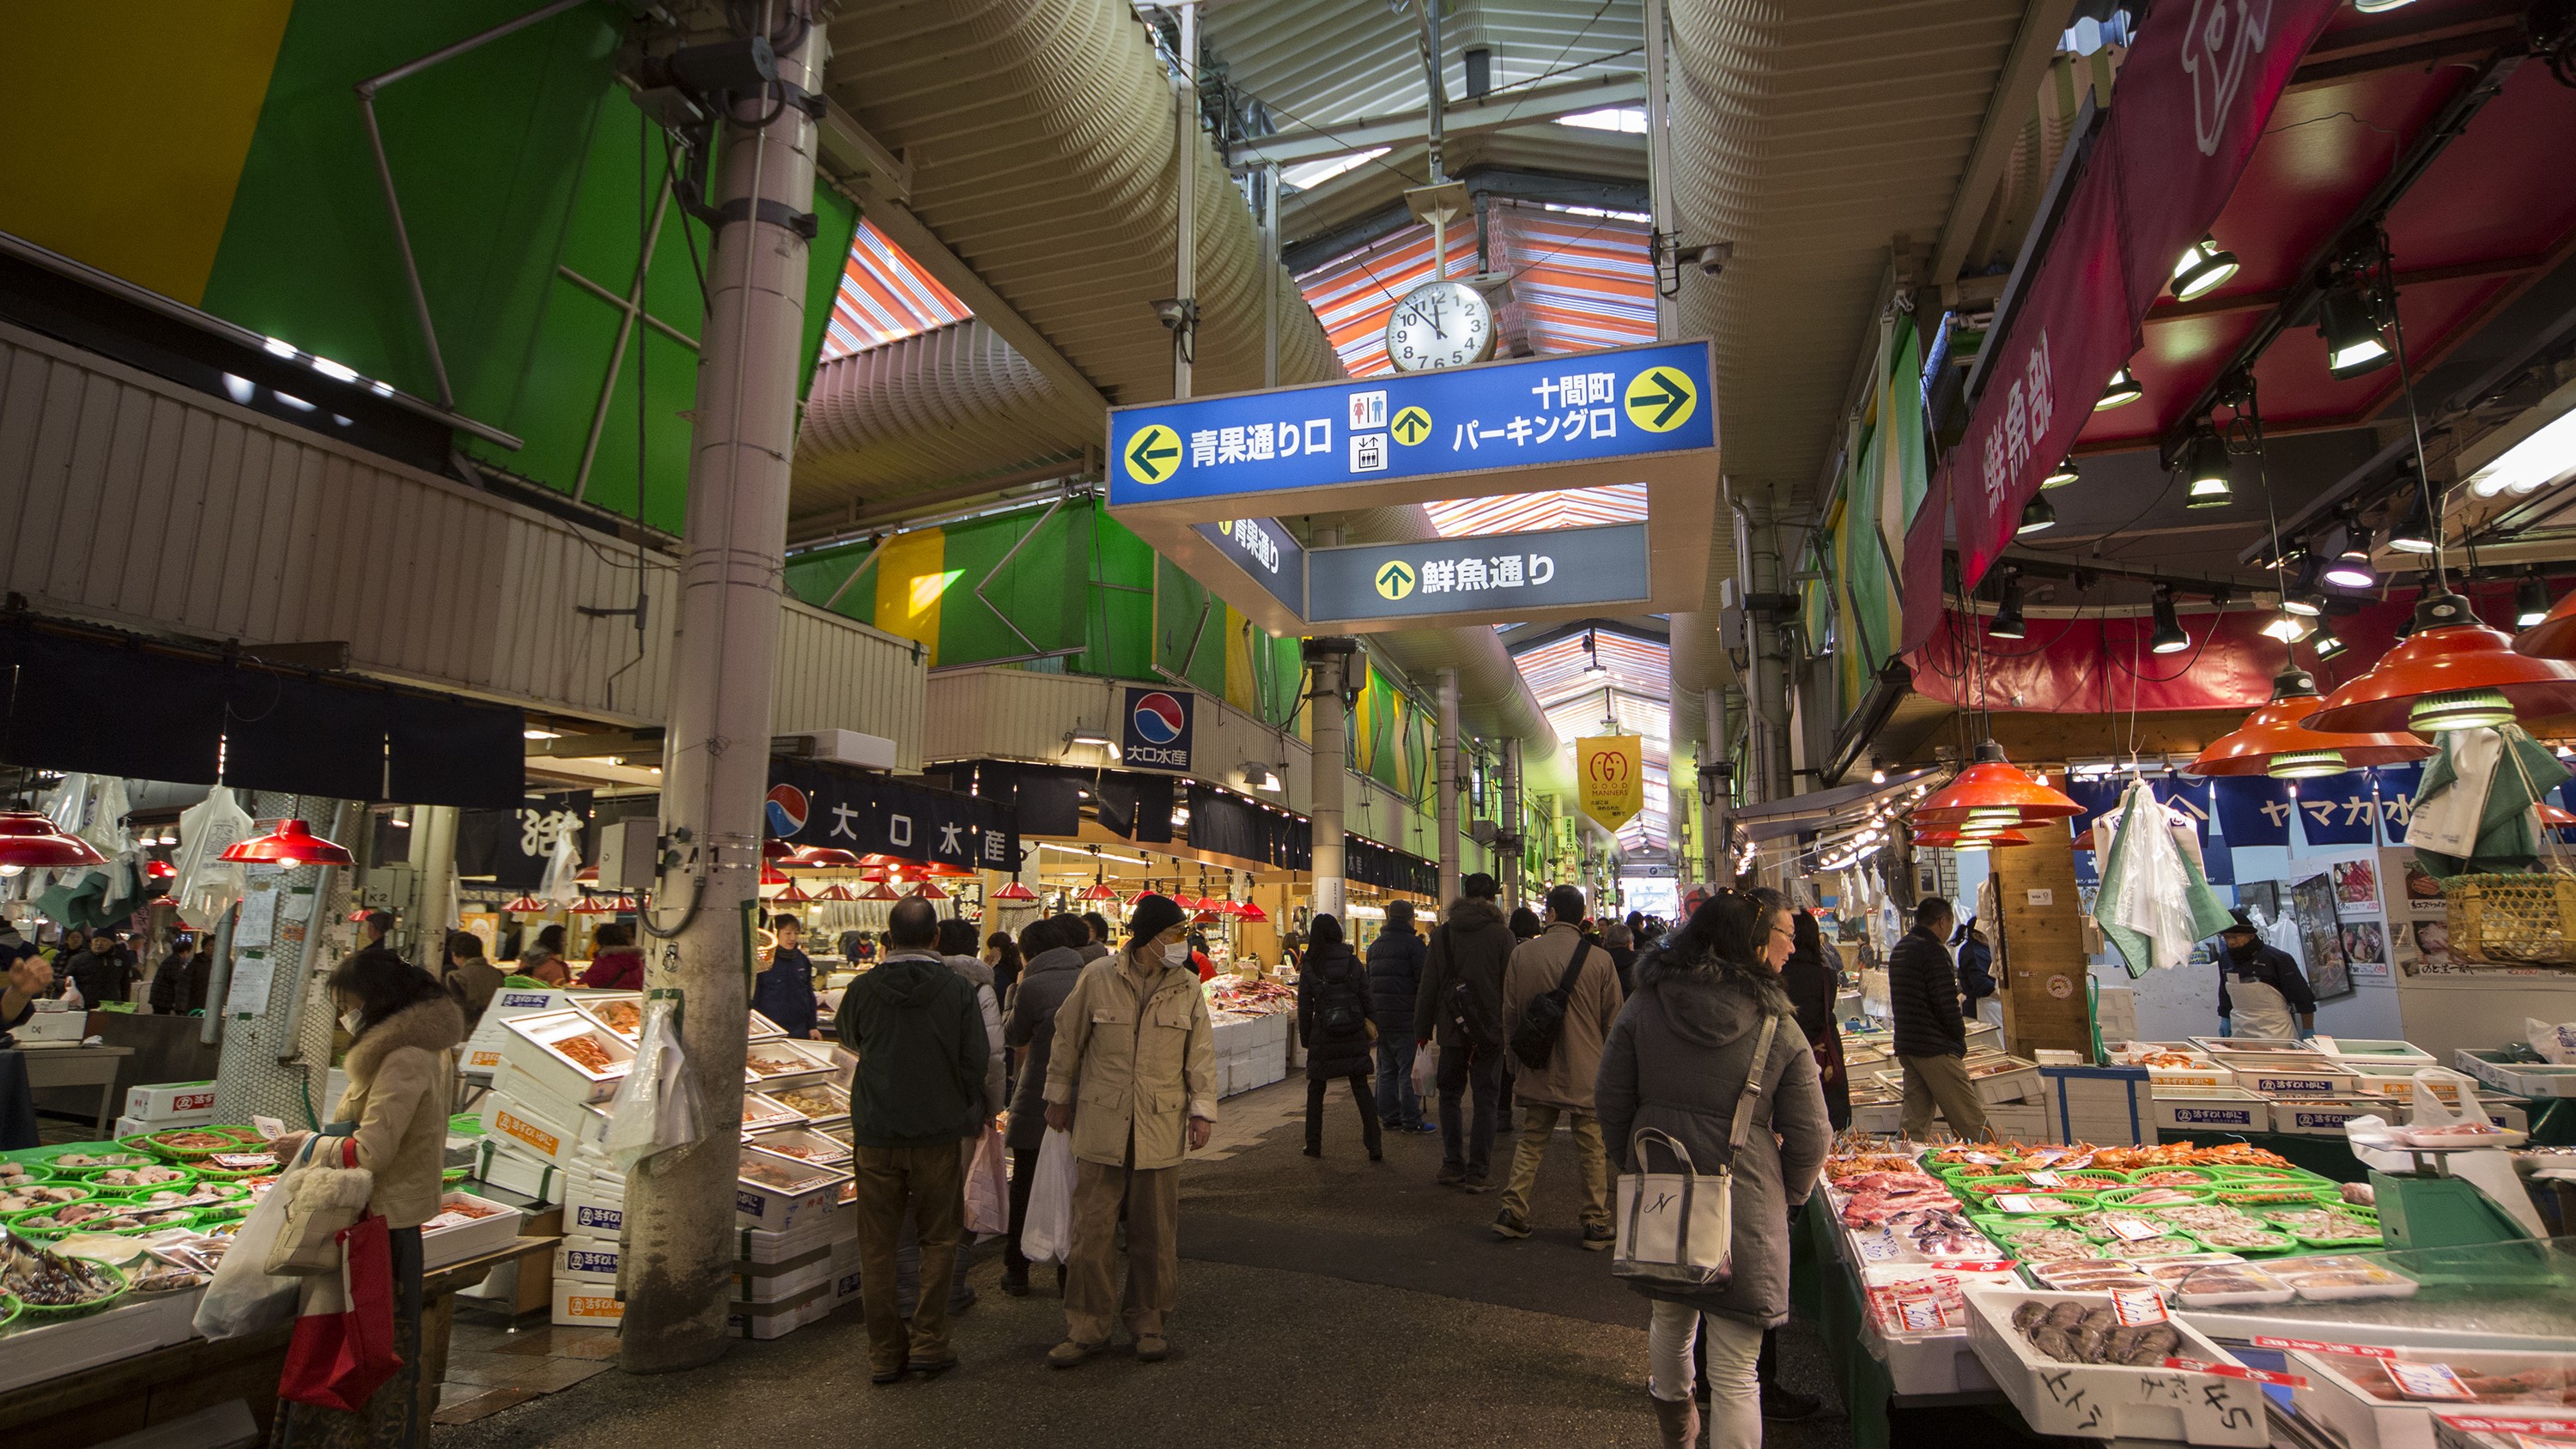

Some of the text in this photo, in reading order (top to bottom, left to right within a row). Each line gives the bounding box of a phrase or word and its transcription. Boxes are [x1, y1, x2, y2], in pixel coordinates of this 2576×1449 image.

[1464, 303, 1475, 317] 2
[1400, 313, 1418, 326] 10
[1470, 319, 1481, 332] 3
[1396, 330, 1407, 343] 9
[1464, 336, 1475, 350] 4
[1403, 346, 1414, 359] 8
[1452, 350, 1463, 364] 5
[1417, 355, 1428, 369] 7
[1434, 358, 1445, 368] 6
[1532, 373, 1616, 409] 十間町
[1983, 324, 2055, 519] 鮮魚部
[1452, 408, 1617, 452] パーキング口
[1190, 418, 1332, 468] 青果通り口
[1421, 554, 1555, 594] 鮮魚通り
[1127, 745, 1188, 766] 大口水産
[829, 803, 1006, 862] 大口水産
[368, 894, 388, 902] K2
[1643, 1191, 1678, 1215] N
